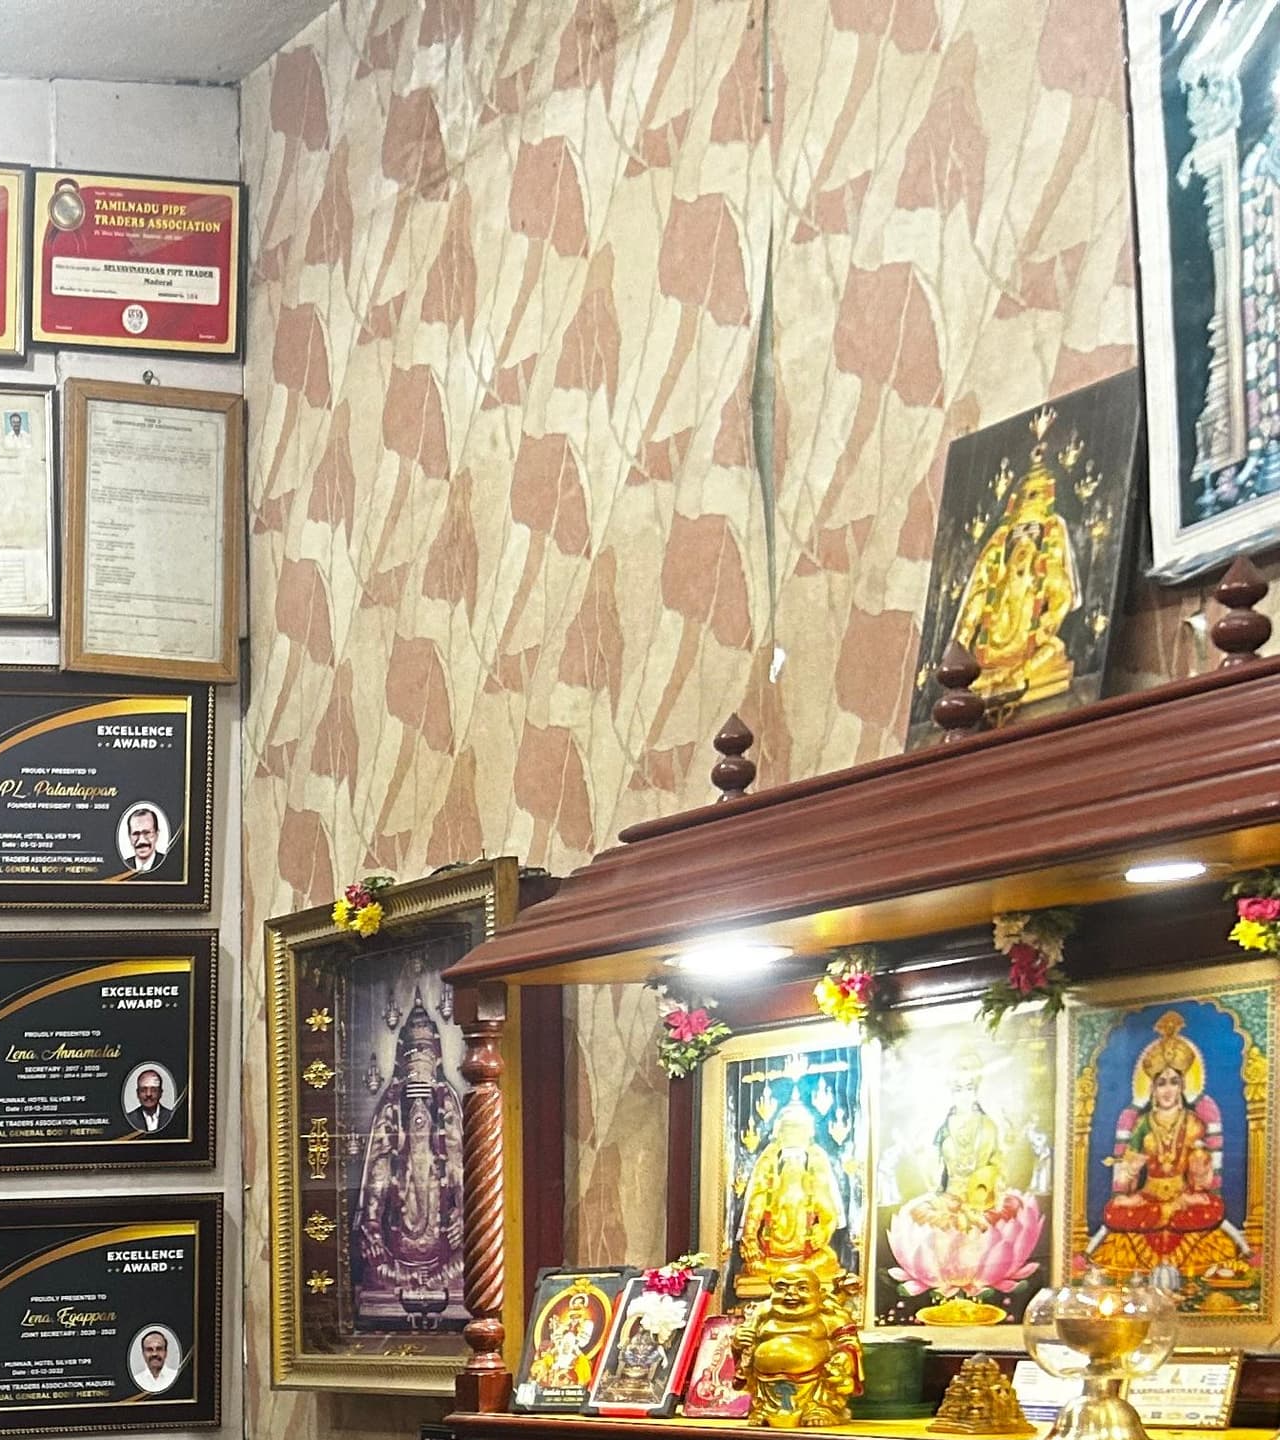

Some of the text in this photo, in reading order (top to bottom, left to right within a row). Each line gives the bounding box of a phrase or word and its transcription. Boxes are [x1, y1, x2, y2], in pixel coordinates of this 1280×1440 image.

[95, 200, 186, 216] TAMILNADU PIPE
[95, 215, 220, 233] TRADERS ASSOCIATION
[97, 725, 173, 737] EXCELLENCE
[113, 739, 157, 749] AWARD
[102, 986, 178, 997] EXCELLENCE
[117, 999, 163, 1010] AWARD
[107, 1250, 184, 1261] EXCELLENCE
[123, 1263, 168, 1273] AWARD
